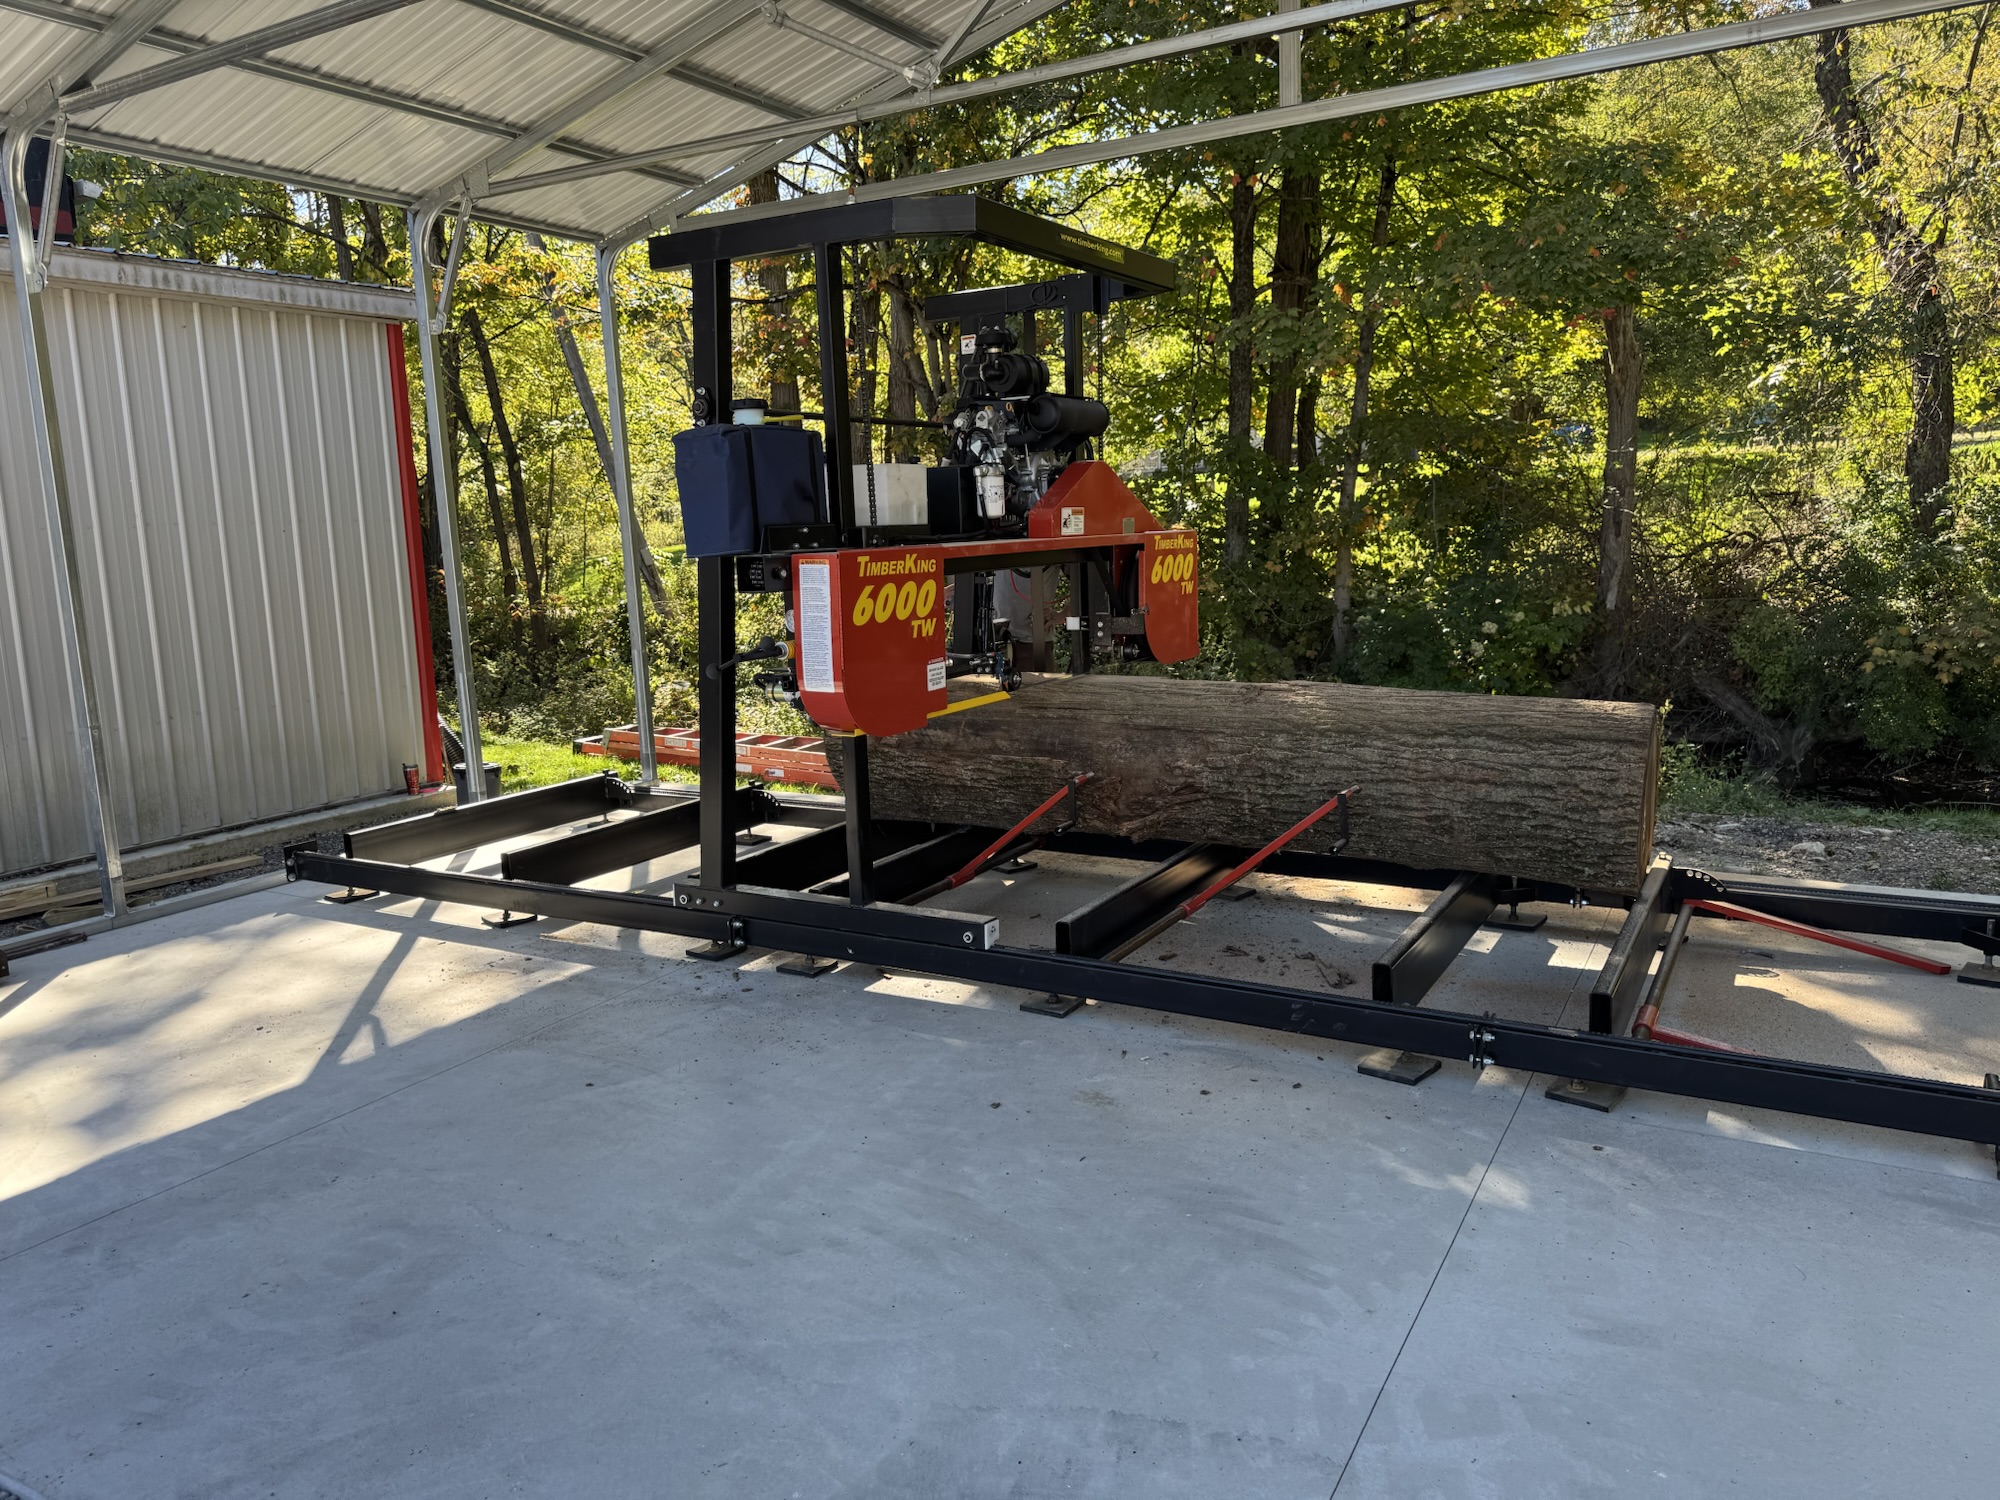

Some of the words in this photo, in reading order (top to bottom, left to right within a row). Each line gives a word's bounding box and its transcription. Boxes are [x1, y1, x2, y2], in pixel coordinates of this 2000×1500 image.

[1060, 233, 1122, 257] www.timberking.com
[1151, 552, 1194, 584] 6000
[1181, 581, 1194, 594] TW
[852, 579, 937, 627] 6000
[911, 617, 937, 639] TW
